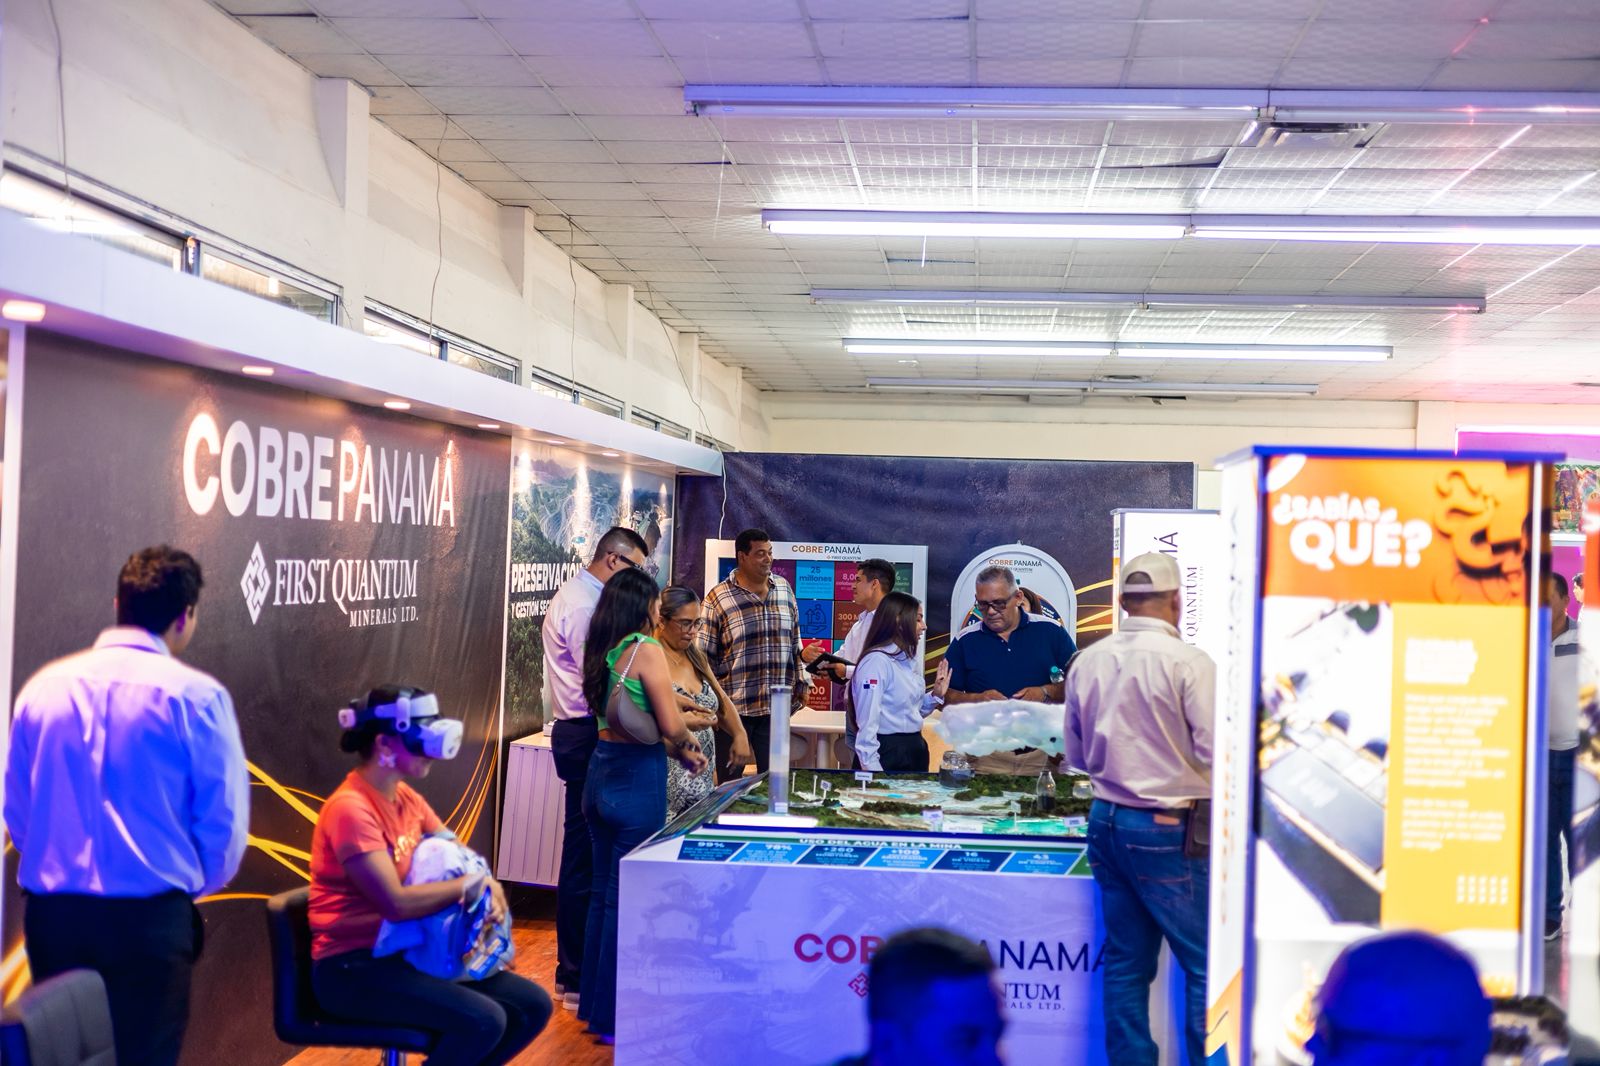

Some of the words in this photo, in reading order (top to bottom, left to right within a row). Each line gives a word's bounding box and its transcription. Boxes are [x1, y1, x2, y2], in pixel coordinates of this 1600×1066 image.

[1289, 507, 1432, 571] QUÉ?
[273, 559, 331, 606] FIRST
[332, 559, 418, 614] QUANTUM
[515, 597, 539, 618] GESTIÓN
[1186, 567, 1199, 637] QUANTUM
[350, 606, 397, 627] MINERALS
[401, 605, 419, 622] LTD.
